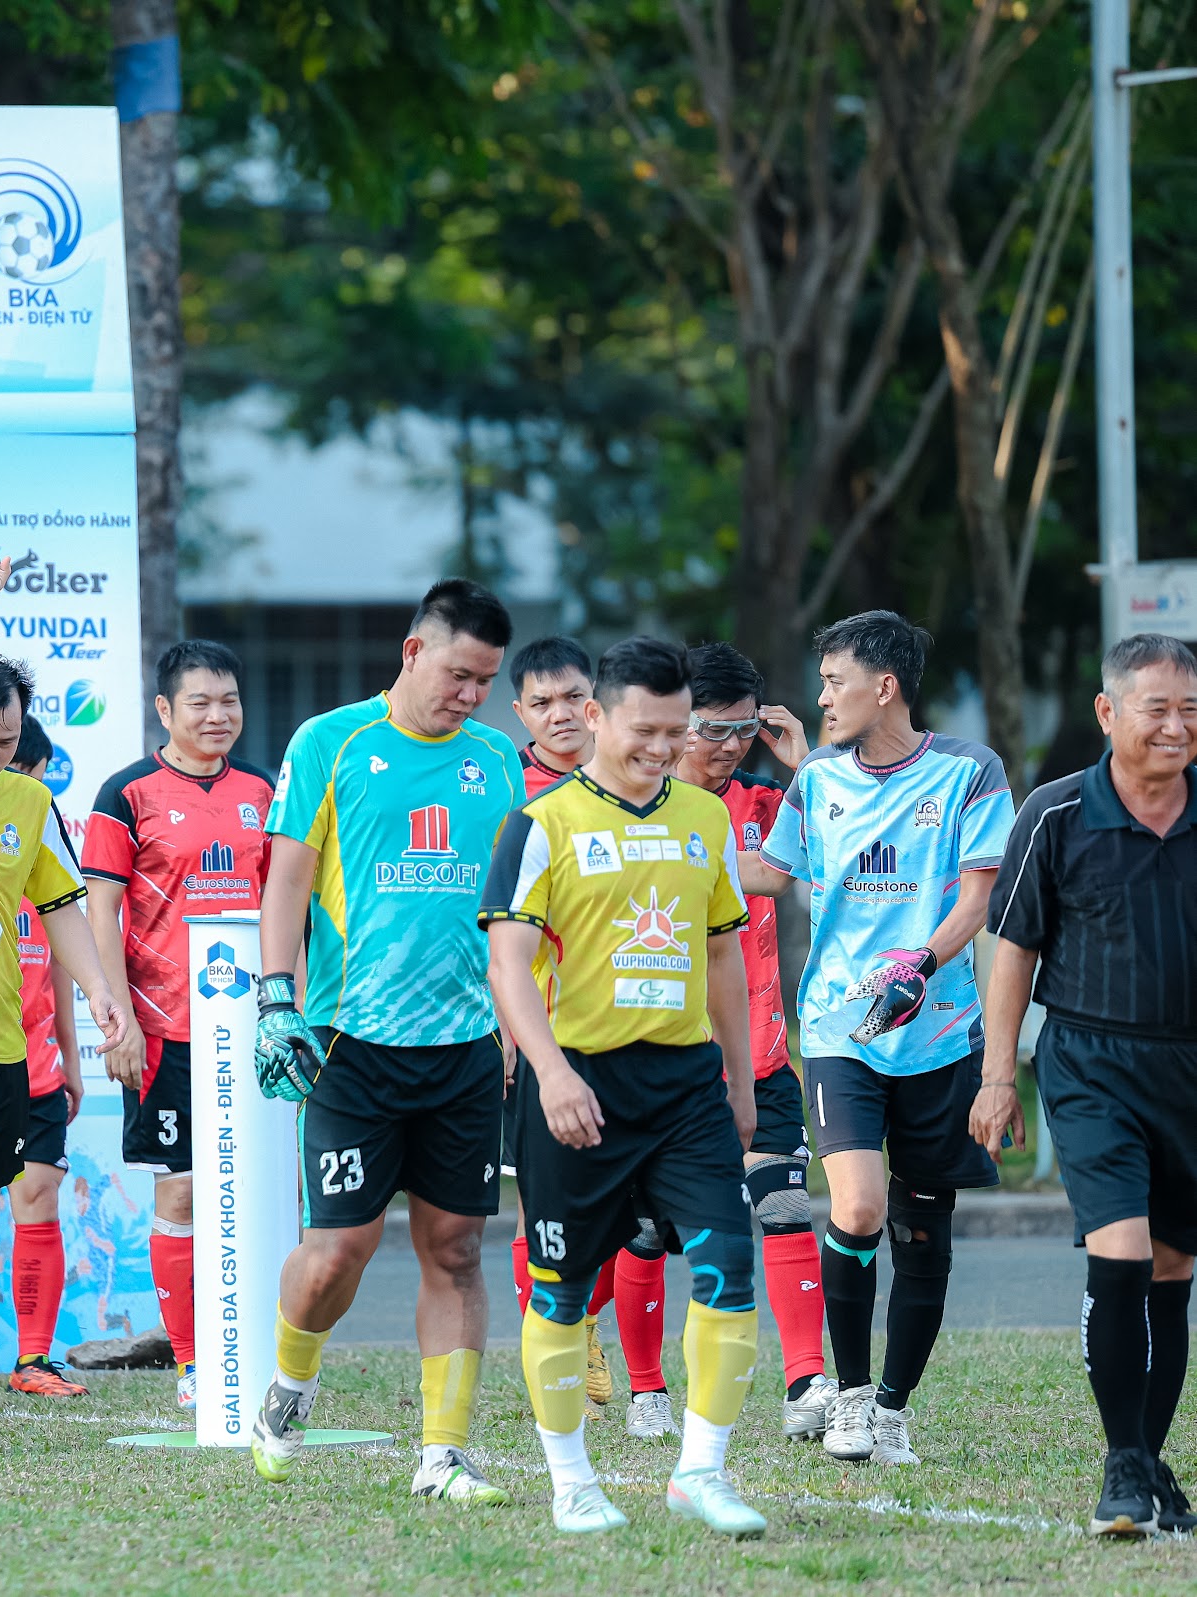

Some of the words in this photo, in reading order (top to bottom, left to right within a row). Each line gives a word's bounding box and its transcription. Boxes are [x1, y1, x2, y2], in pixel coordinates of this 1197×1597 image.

[9, 288, 59, 307] BKA
[27, 310, 66, 328] ĐIỆN
[68, 309, 93, 325] TỬ
[12, 513, 39, 529] TRỢ
[43, 509, 85, 527] ĐỒNG
[91, 511, 131, 527] HÀNH
[2, 562, 108, 594] ocker
[46, 642, 107, 660] XTeer
[375, 862, 477, 887] DECOFI
[587, 856, 613, 867] BKE
[182, 874, 251, 890] Eurostone
[842, 876, 919, 893] Eurostone
[208, 965, 234, 976] BKA
[613, 954, 691, 970] VUPHONG.COM
[213, 1024, 231, 1055] TỬ
[215, 1061, 235, 1109] ĐIỆN
[158, 1109, 178, 1145] 3
[217, 1126, 238, 1174] ĐIỆN
[319, 1147, 365, 1196] 23
[220, 1179, 236, 1238] KHOA
[535, 1219, 566, 1261] 15
[221, 1245, 237, 1286] CSV
[220, 1292, 238, 1322] ĐÁ
[220, 1327, 240, 1387] BÓNG
